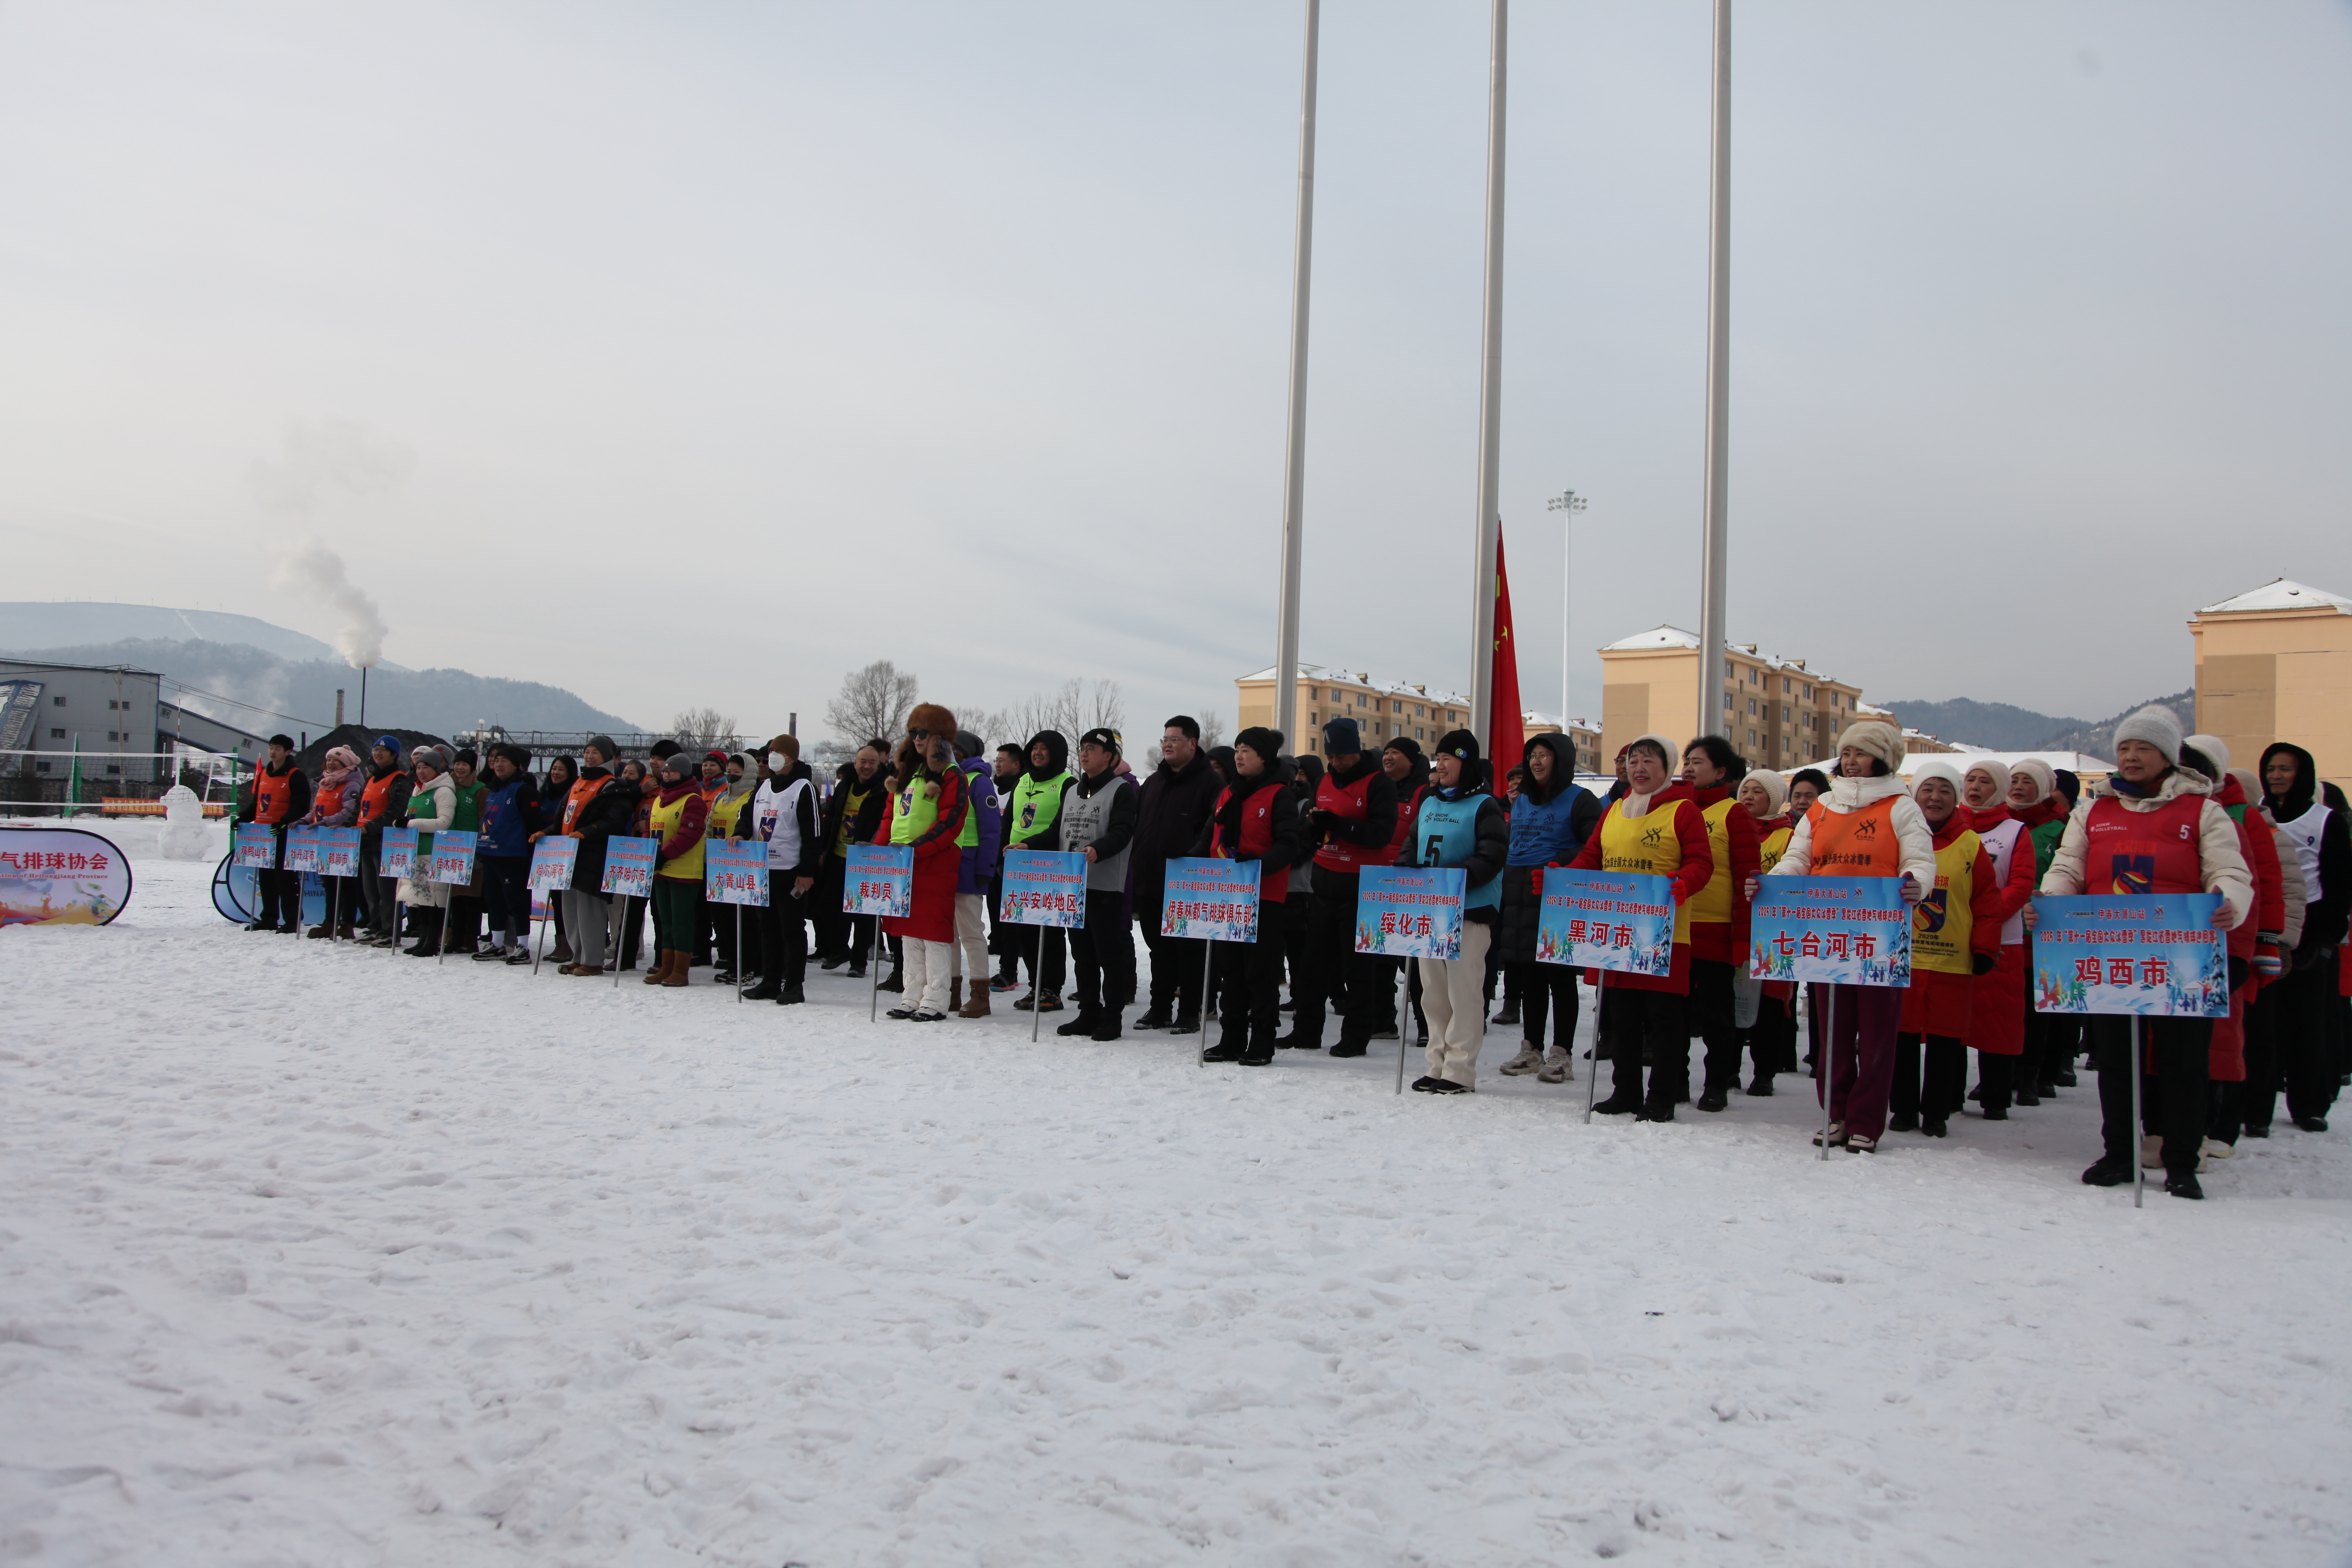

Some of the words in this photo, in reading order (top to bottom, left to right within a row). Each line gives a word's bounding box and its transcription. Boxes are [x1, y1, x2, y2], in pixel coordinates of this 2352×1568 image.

[1357, 798, 1362, 807] 6
[1405, 805, 1411, 814] 3
[675, 811, 680, 820] 9
[1258, 807, 1265, 817] 9
[2179, 824, 2190, 839] 5
[2113, 840, 2156, 854] 大众排球
[2307, 836, 2315, 846] 9
[241, 845, 268, 857] 双鸭山市
[291, 848, 315, 859] 牡丹江市
[328, 852, 348, 864] 鹤岗市
[0, 851, 109, 870] 气排球协会
[389, 853, 406, 865] 大庆市
[436, 856, 465, 872] 佳木斯市
[536, 863, 565, 877] 哈尔滨市
[609, 864, 646, 882] 齐齐哈尔市
[715, 872, 756, 890] 大箐山县
[1589, 882, 1623, 893] 伊春大箐山站
[859, 881, 892, 899] 裁判员
[1808, 888, 1847, 900] 伊春大箐山站
[1007, 889, 1077, 911] 大兴安岭地区
[1168, 900, 1252, 925] 伊春林都气排球俱乐部
[2098, 908, 2146, 921] 伊春大箐山站
[1380, 911, 1432, 936] 绥化市
[1567, 919, 1633, 948] 黑河市
[1772, 930, 1877, 959] 七台河市
[2074, 955, 2168, 987] 鸡西市
